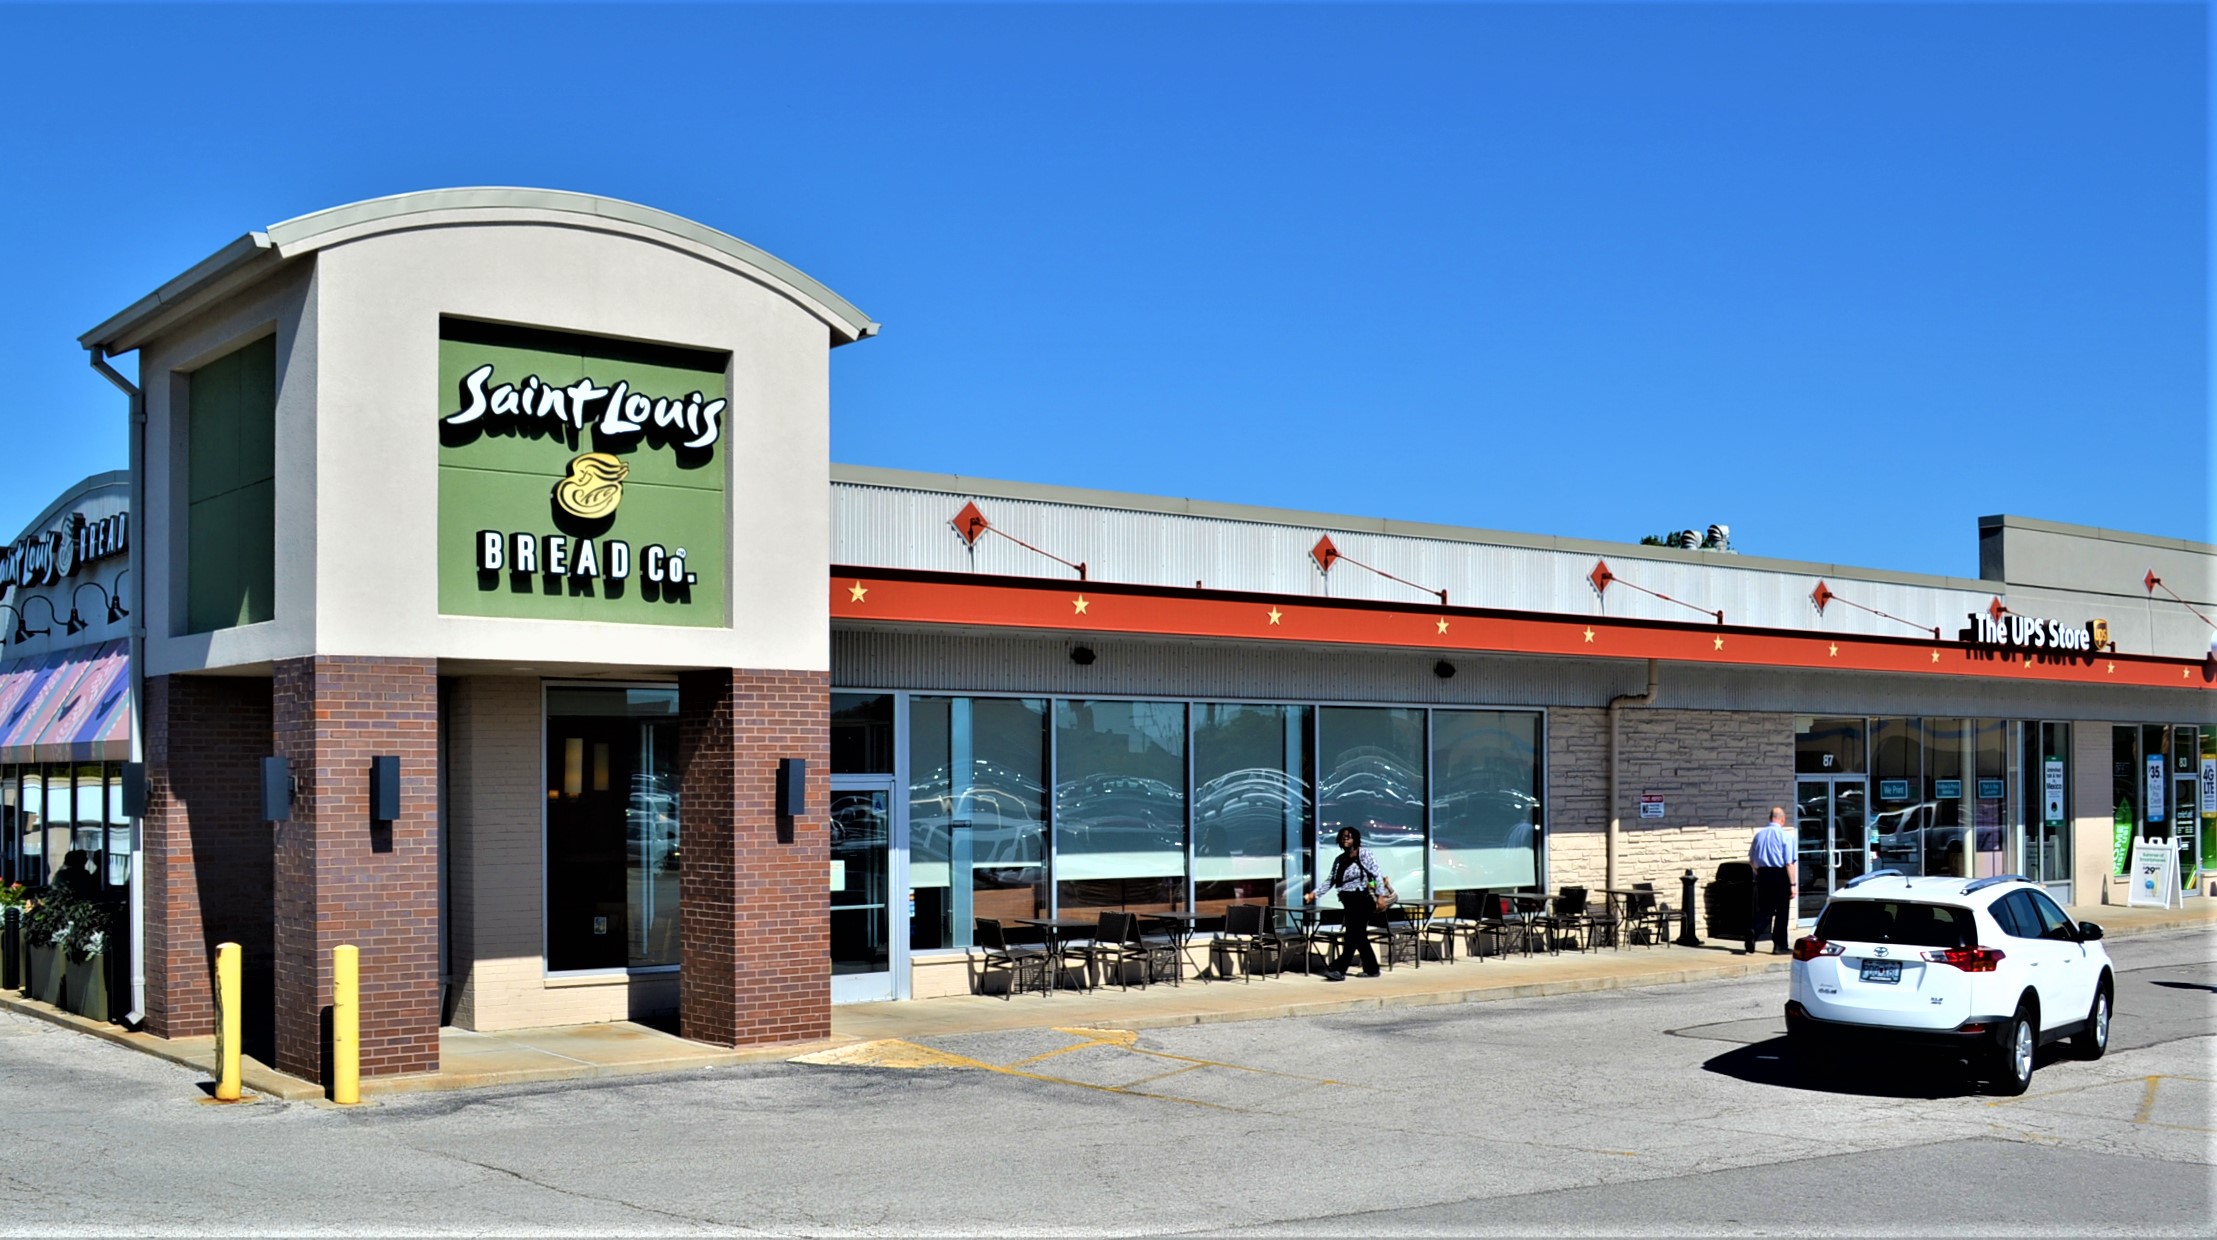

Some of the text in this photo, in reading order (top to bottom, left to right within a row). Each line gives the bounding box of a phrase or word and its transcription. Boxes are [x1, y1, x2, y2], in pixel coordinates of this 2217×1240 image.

[446, 364, 727, 448] Saint Louis
[80, 513, 126, 562] BREAD
[484, 531, 695, 583] BREAD Co.
[0, 533, 55, 587] aint Louis
[1975, 613, 2090, 650] The UPS Store
[1822, 754, 1835, 767] 87
[2202, 768, 2215, 781] 4G
[2203, 782, 2215, 794] LTE
